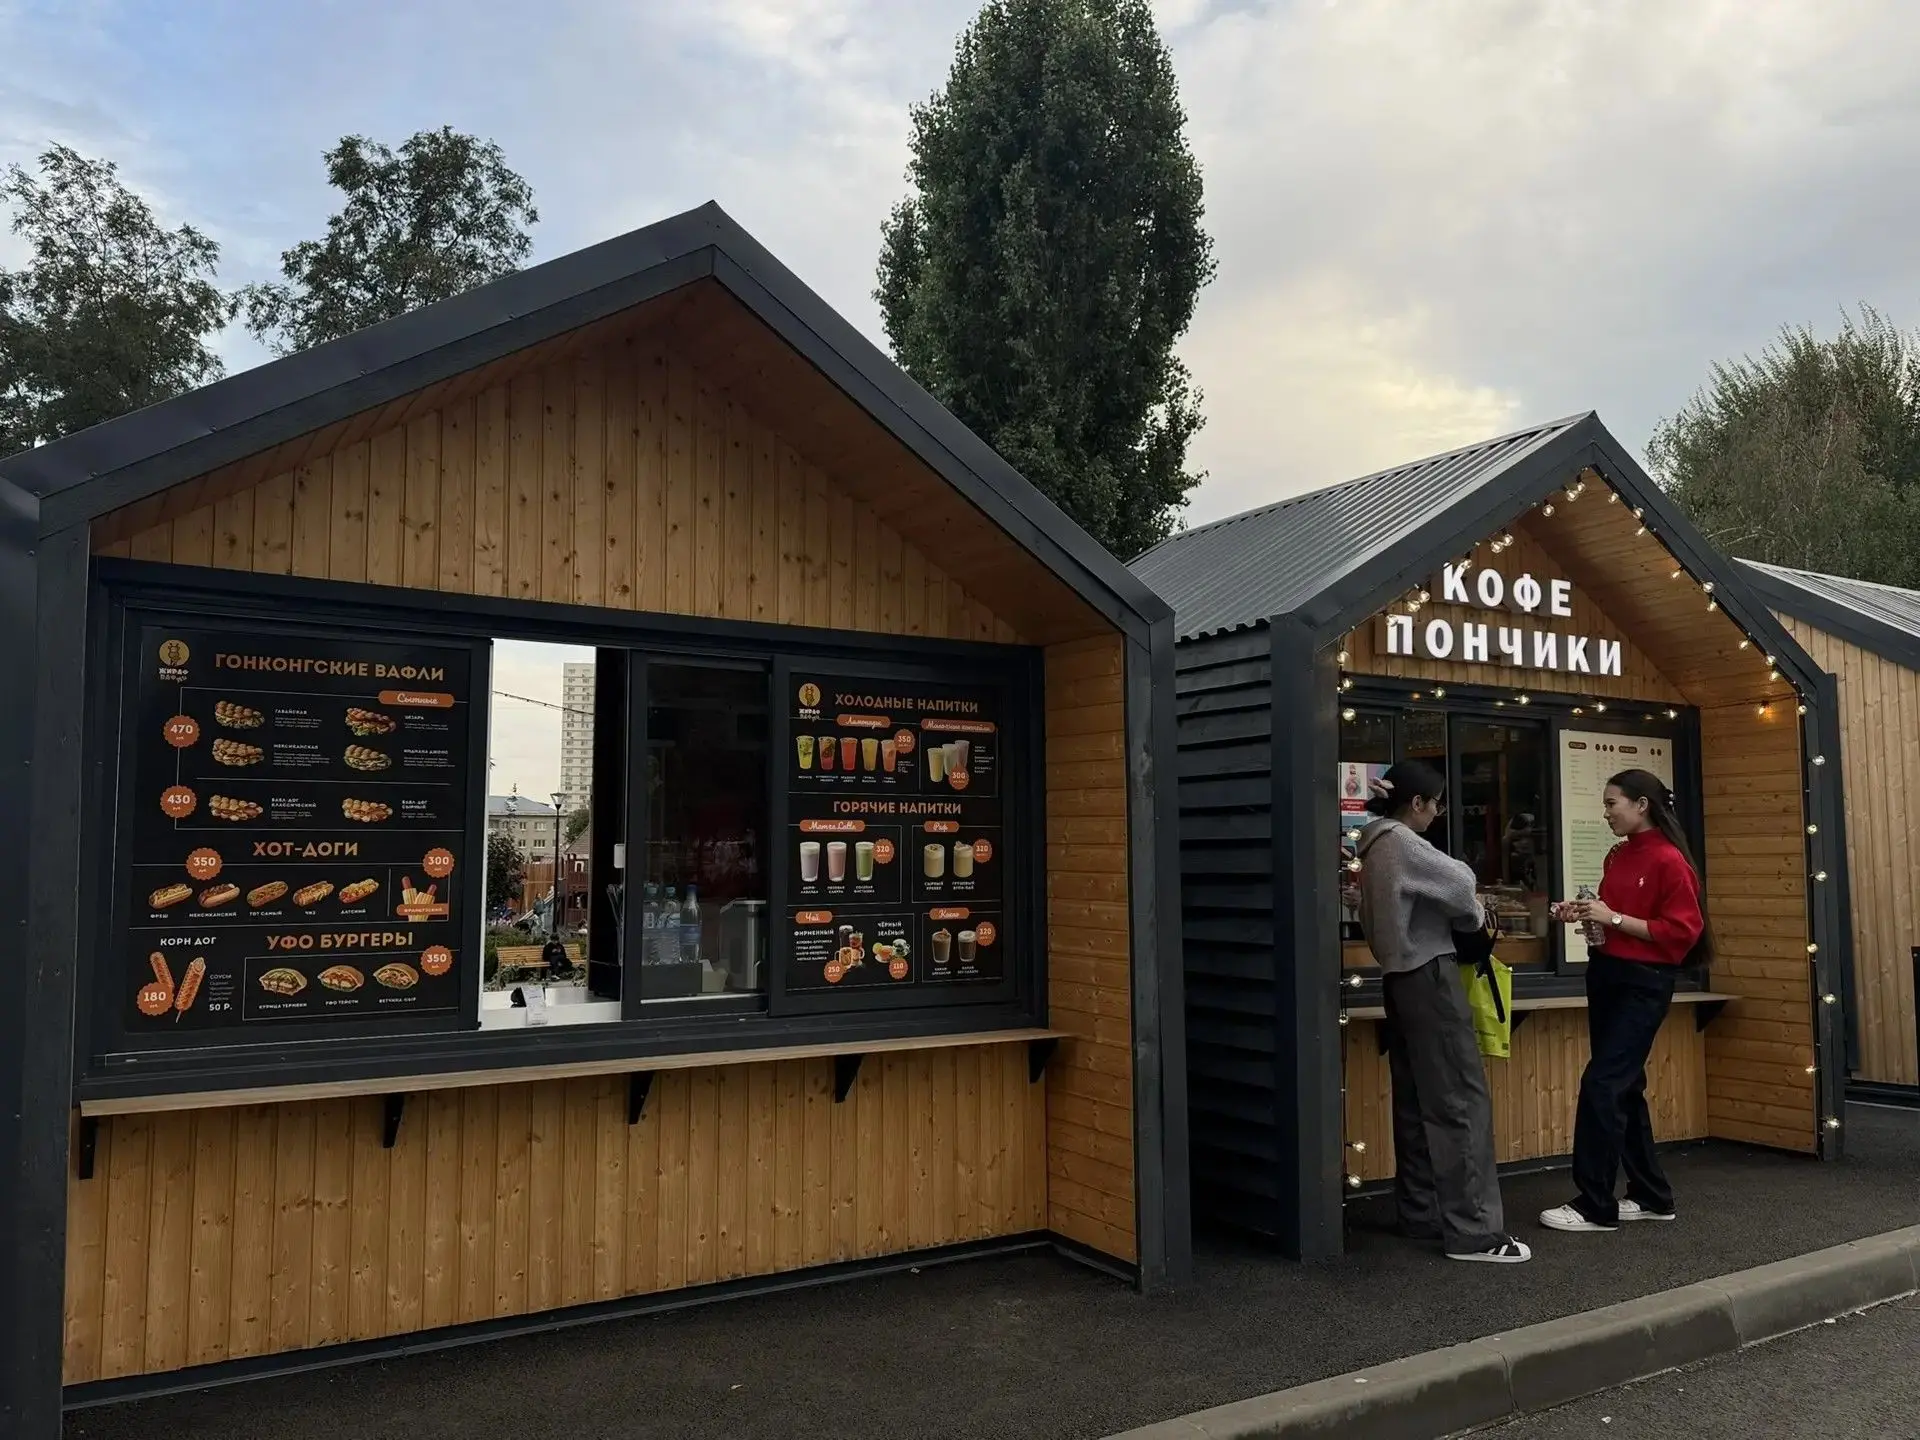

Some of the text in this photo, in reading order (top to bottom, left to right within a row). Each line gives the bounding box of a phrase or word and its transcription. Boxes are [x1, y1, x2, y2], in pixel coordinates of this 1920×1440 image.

[1443, 562, 1572, 617] КОФЕ
[1386, 613, 1622, 676] ПОНЧИКИ
[215, 653, 444, 681] ГОНКОНГСКИЕ ВАФЛИ
[397, 693, 439, 704] Сытные
[835, 693, 979, 713] ХОЛОДНЫЕ НАПИТКИ
[170, 725, 193, 734] 470
[168, 795, 191, 804] 430
[833, 801, 962, 815] ГОРЯЧИЕ НАПИТКИ
[252, 841, 358, 858] ХОТ-ДОГИ
[193, 856, 216, 867] 350
[428, 856, 449, 866] 300
[794, 928, 834, 936] ФИРМЕННЫЙ
[160, 936, 217, 946] КОРН ДОГ
[266, 931, 413, 951] УФО БУРГЕРЫ
[426, 954, 447, 963] 350
[143, 991, 167, 1002] 180
[209, 1003, 221, 1011] 50
